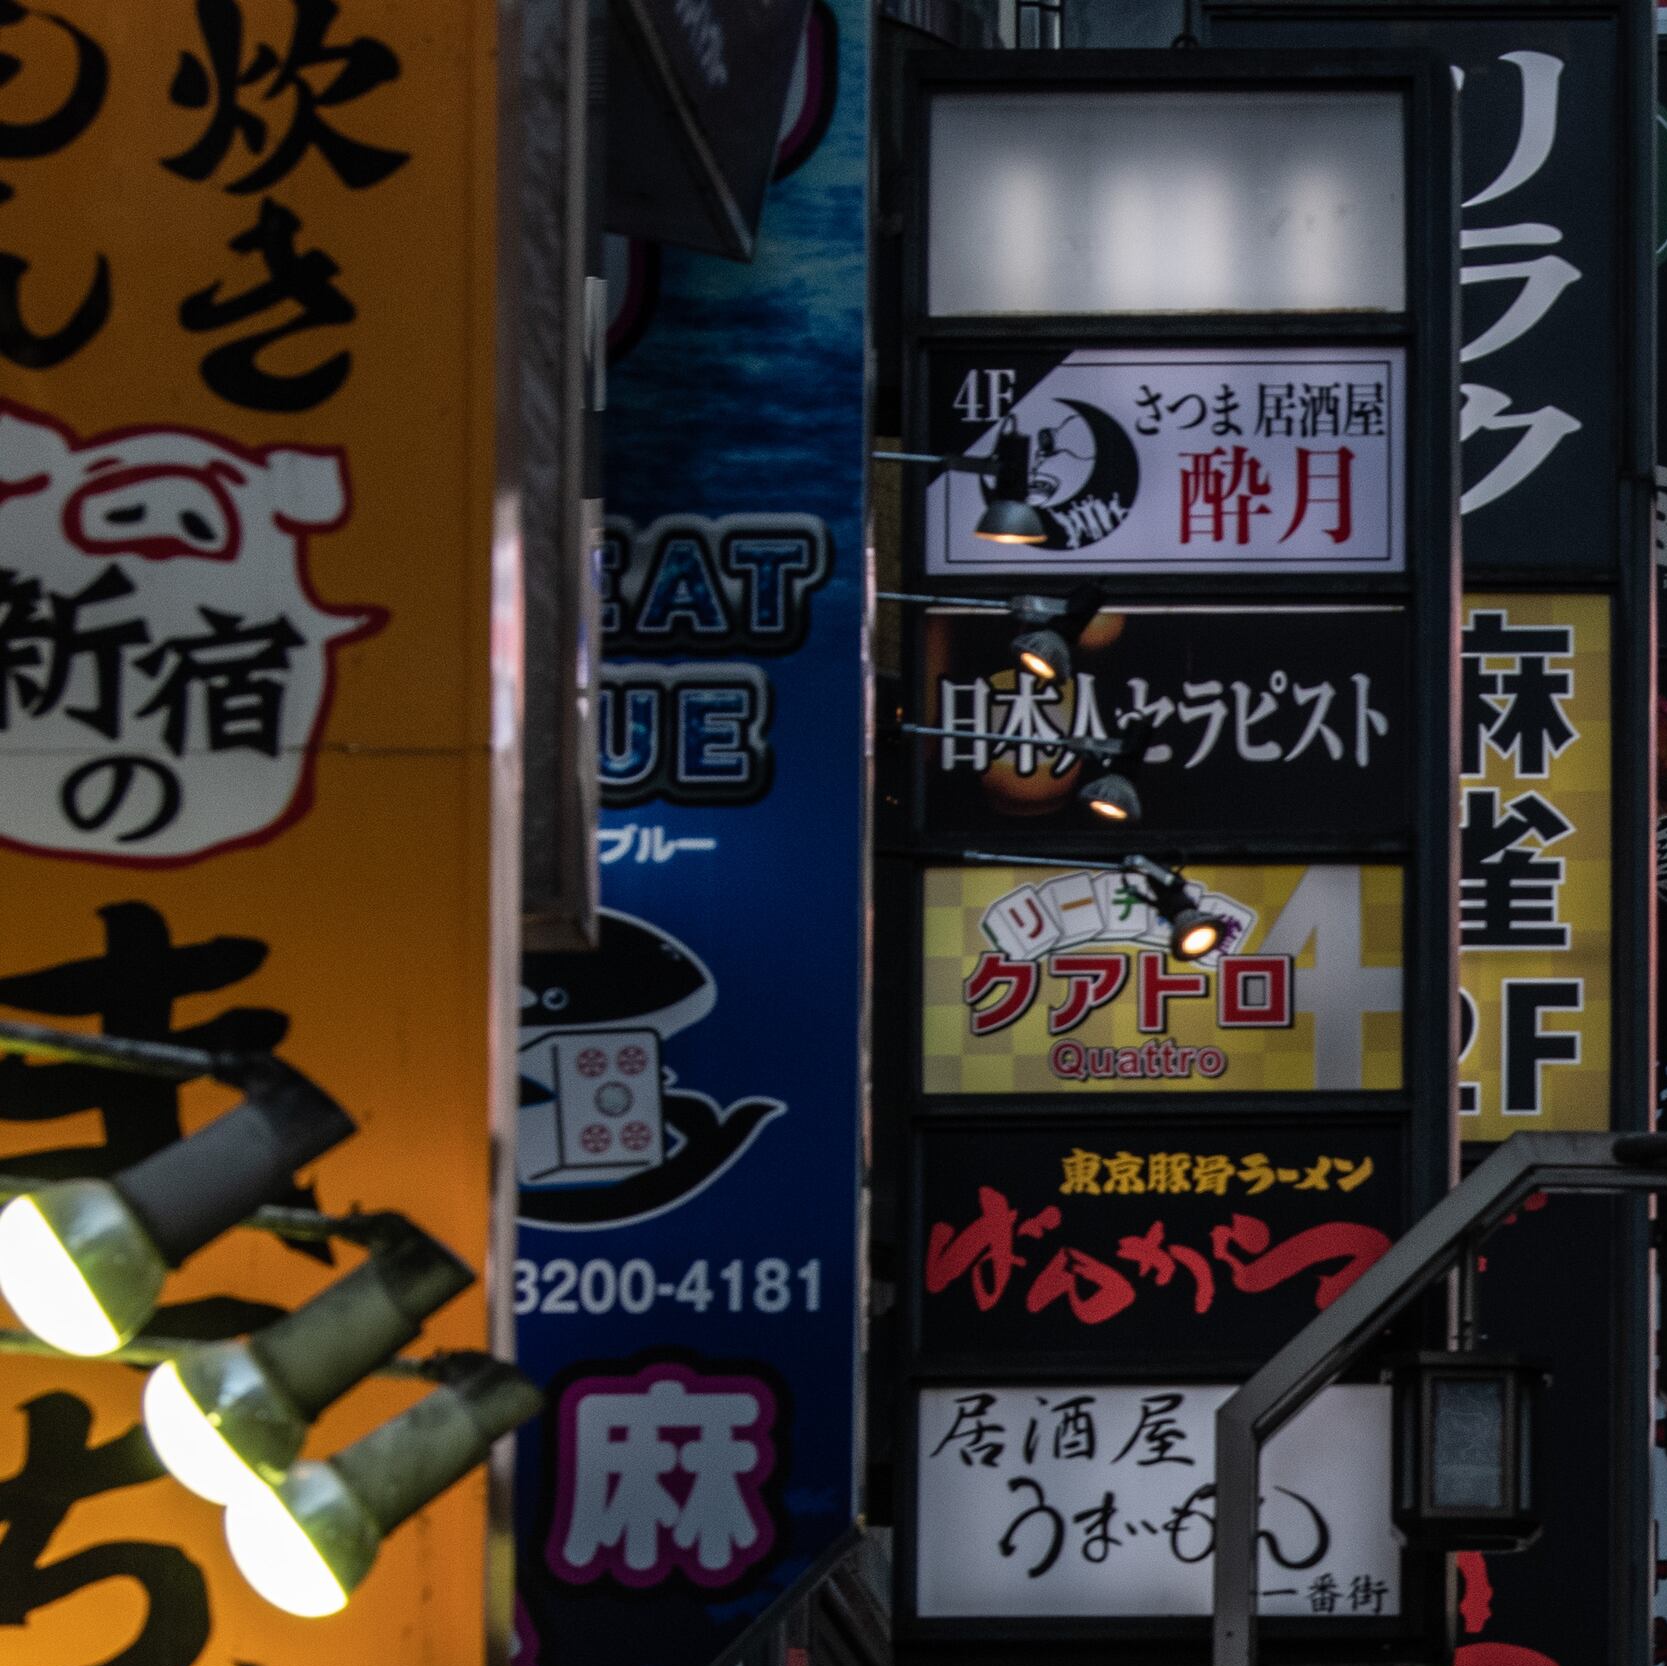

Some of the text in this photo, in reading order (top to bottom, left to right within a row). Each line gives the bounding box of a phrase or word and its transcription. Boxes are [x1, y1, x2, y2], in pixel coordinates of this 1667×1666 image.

[953, 368, 1018, 424] 4F
[1178, 446, 1357, 546] 酔月
[964, 952, 1294, 1034] クアトロ
[1050, 1038, 1227, 1080] Quattro
[1058, 1147, 1375, 1198] 東京豚骨ラーメン
[930, 1392, 1196, 1468] 居酒屋
[1256, 1573, 1389, 1616] 一番街
